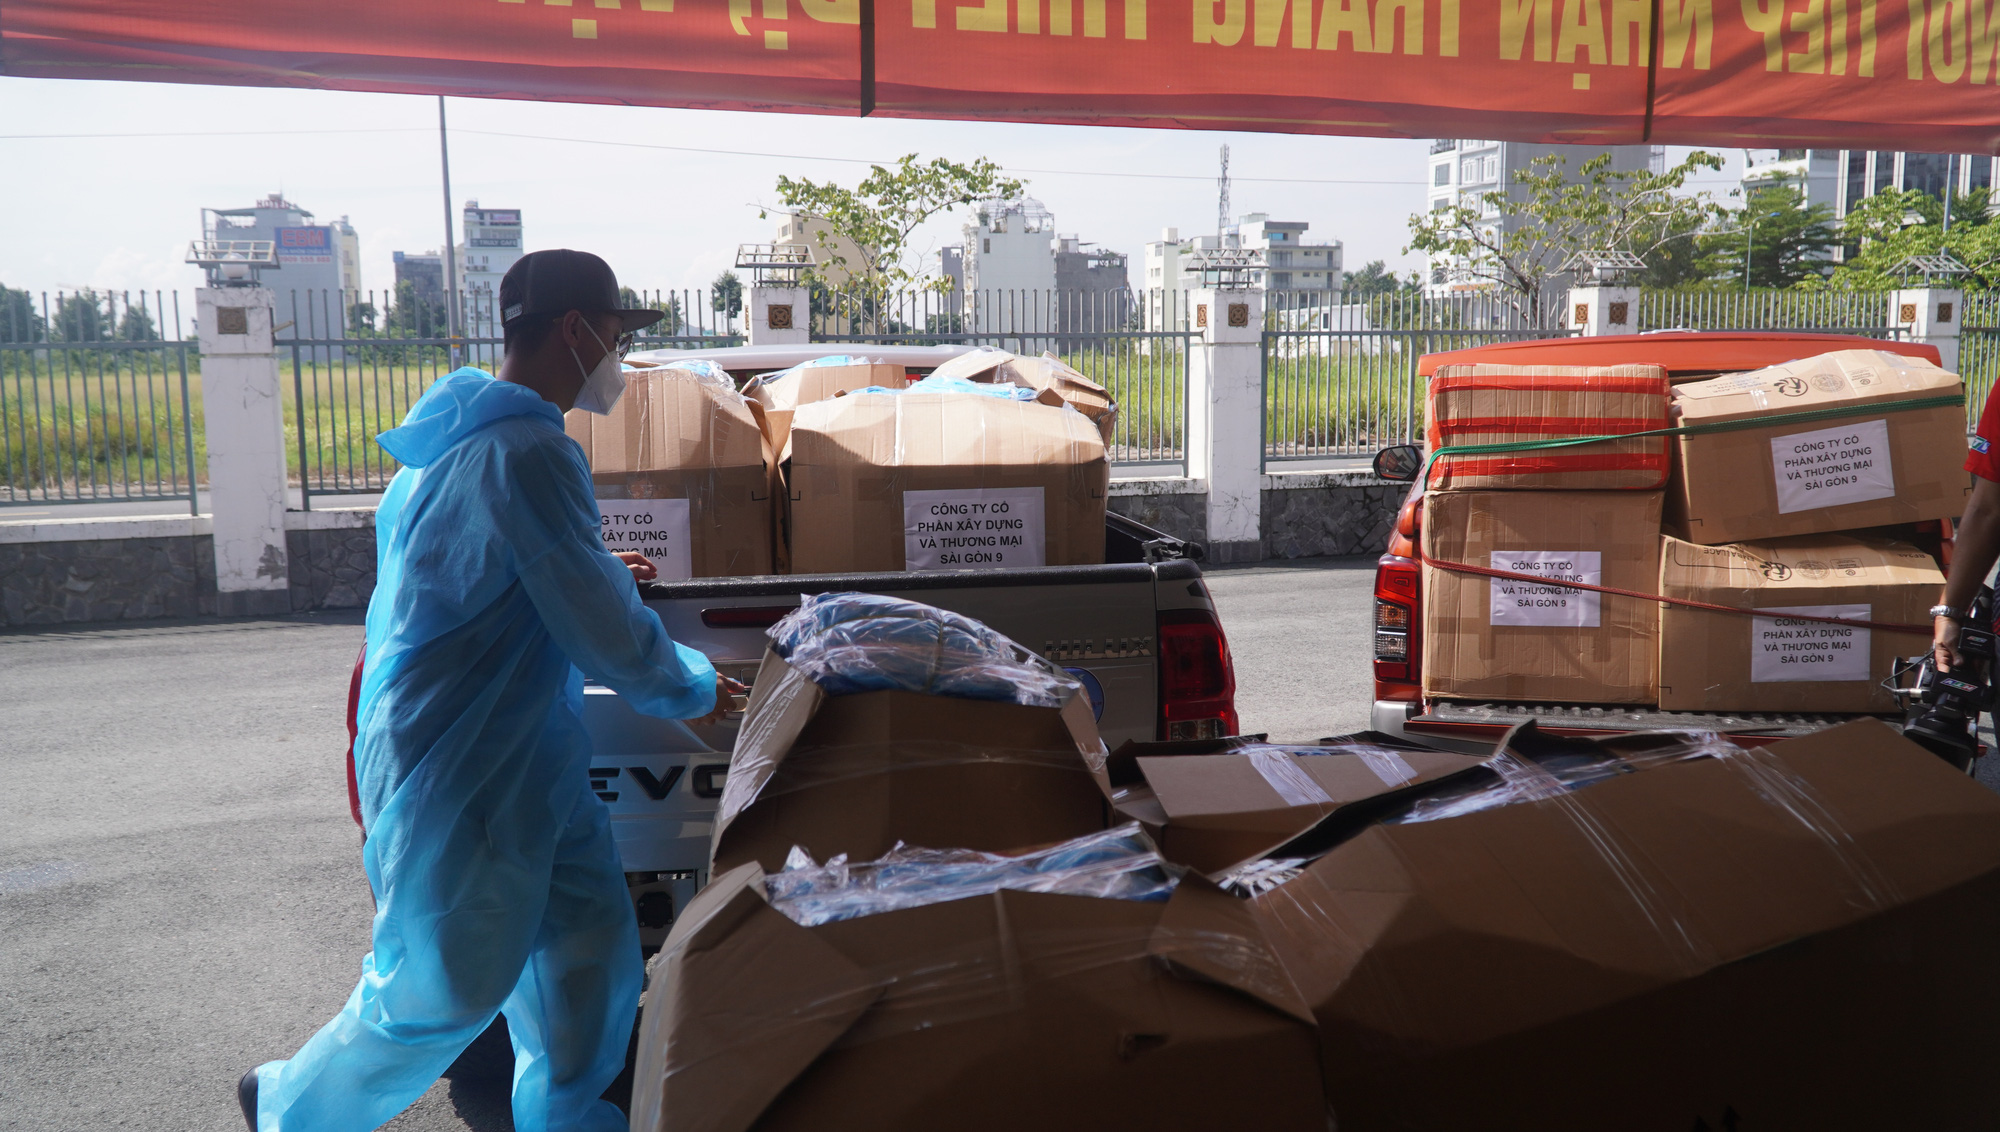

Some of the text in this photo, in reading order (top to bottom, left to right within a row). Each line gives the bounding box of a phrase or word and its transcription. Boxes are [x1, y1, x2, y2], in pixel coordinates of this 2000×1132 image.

[282, 230, 324, 247] EBM
[1794, 434, 1859, 454] CÔNG TY CỔ
[1785, 446, 1872, 468] PHẦN XÂY DỰNG
[1787, 460, 1872, 480] VÀ THƯƠNG MẠI
[1805, 475, 1858, 490] SÀI GÒN 9
[931, 500, 1009, 516] CÔNG TY CỔ
[614, 514, 630, 524] TY
[634, 512, 652, 524] CỔ
[918, 518, 1023, 532] PHẦN XÂY DỰNG
[629, 530, 668, 543] DỰNG
[920, 536, 1022, 548] VÀ THƯƠNG MẠI
[644, 547, 667, 560] MẠI
[940, 551, 1002, 564] SÀI GÒN 9
[1512, 560, 1572, 570] CÔNG TY CỔ
[1502, 585, 1582, 596] VÀ THƯƠNG MẠI
[1518, 598, 1534, 607] SÀI
[1536, 598, 1558, 607] GÒN
[1764, 628, 1852, 640] PHẦN XÂY DỰNG
[1045, 636, 1153, 660] HILUX
[1764, 642, 1851, 652] VÀ THƯƠNG MẠI
[1781, 654, 1798, 664] SÀI
[1802, 653, 1824, 662] GÒN
